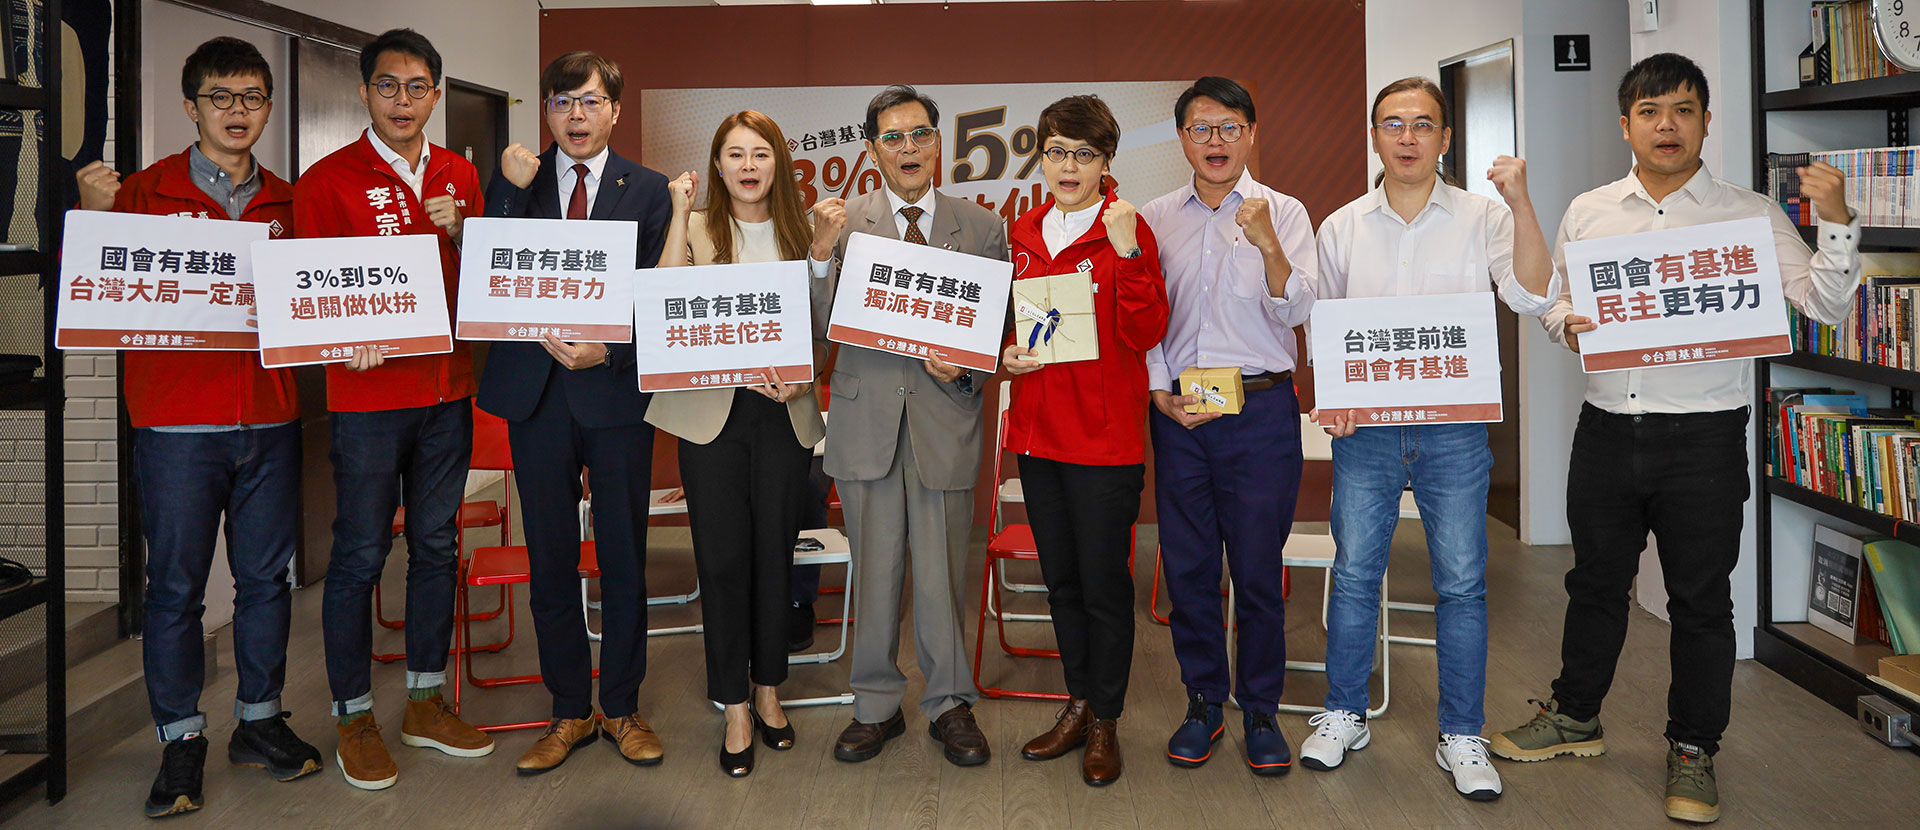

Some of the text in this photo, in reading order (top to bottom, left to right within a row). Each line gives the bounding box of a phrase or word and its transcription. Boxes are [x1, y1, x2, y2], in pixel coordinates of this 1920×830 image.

[1894, 0, 1904, 16] 9
[1900, 21, 1910, 38] 8
[366, 186, 401, 236] 李宗
[101, 246, 237, 275] 國會有基進
[491, 247, 608, 272] 國會有基進
[1589, 244, 1759, 292] 國會有基進
[296, 266, 409, 290] 3%到5%
[488, 275, 605, 300] 監督更有力
[869, 262, 982, 303] 國會有基進
[664, 292, 782, 320] 國會有基進
[863, 287, 977, 328] 獨派有聲音
[1596, 279, 1761, 325] 民主更有力
[132, 333, 183, 346] 台灣基進
[665, 320, 783, 348] 共諜走佗去
[886, 338, 929, 356] 台灣基進
[1343, 325, 1467, 354] 台灣要前進
[1652, 347, 1705, 363] 台灣基進
[700, 373, 744, 386] 台灣基進
[1344, 354, 1469, 383] 國會有基進
[1380, 409, 1427, 422] 台灣基進
